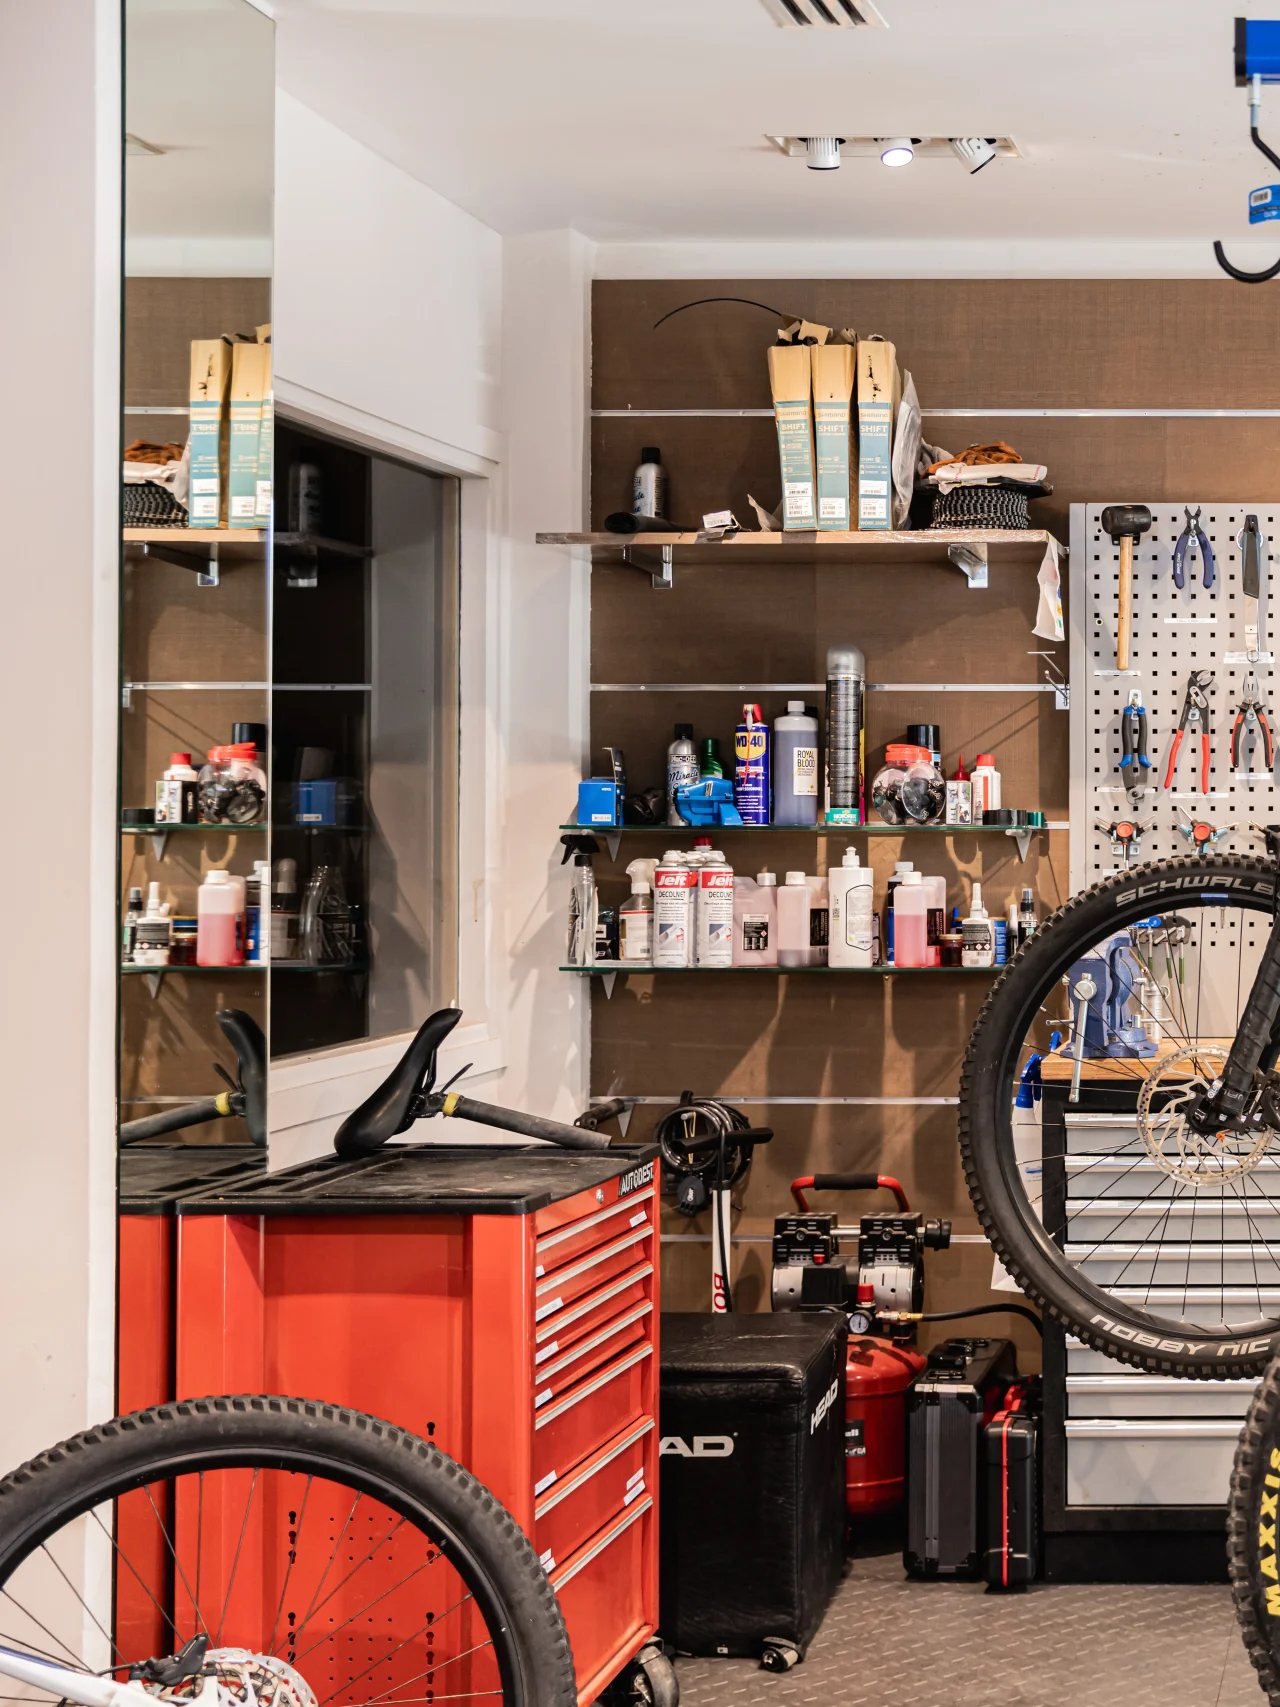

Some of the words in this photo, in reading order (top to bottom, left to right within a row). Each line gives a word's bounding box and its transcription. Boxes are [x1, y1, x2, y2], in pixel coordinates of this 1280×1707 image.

[781, 423, 807, 431] SHIFT
[818, 425, 846, 433] SHIFT
[860, 425, 888, 433] SHIFT
[736, 735, 763, 747] WD40
[797, 750, 815, 759] ROYAL
[797, 759, 816, 768] BLOOD
[1116, 876, 1275, 907] SCHWALB
[1090, 1314, 1207, 1356] NOBBY
[811, 1379, 838, 1435] HEAD
[658, 1436, 734, 1457] AD
